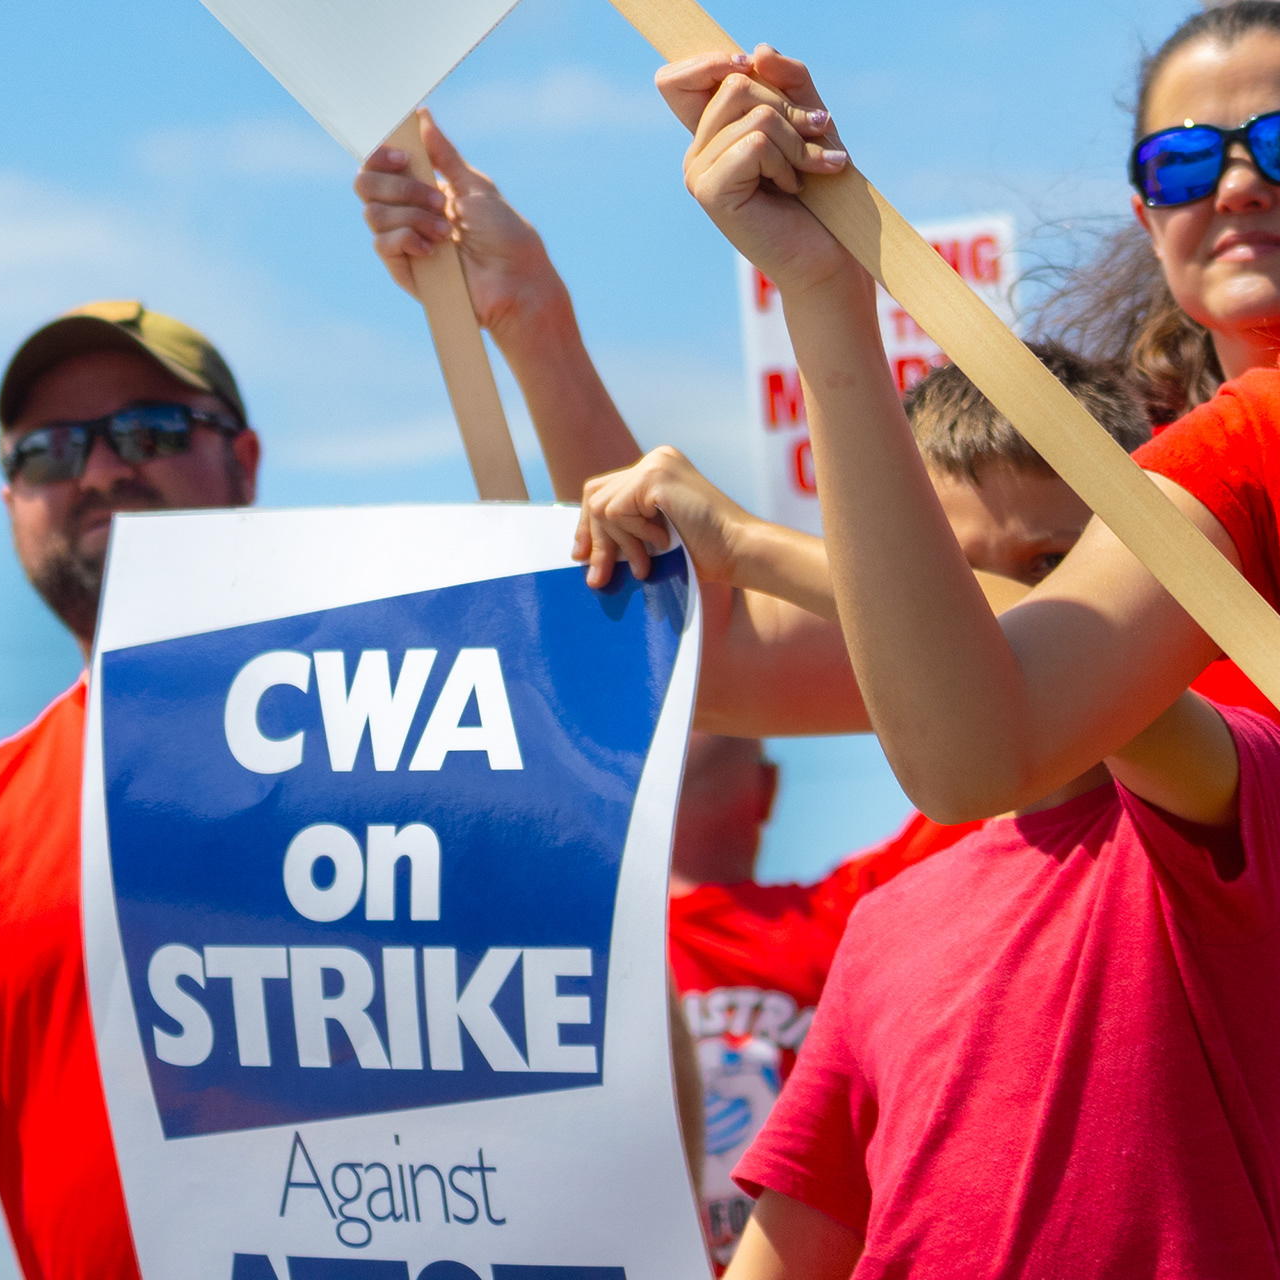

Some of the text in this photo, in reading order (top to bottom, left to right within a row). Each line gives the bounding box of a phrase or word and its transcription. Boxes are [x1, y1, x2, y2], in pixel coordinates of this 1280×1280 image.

[224, 647, 523, 774] CWA
[283, 822, 440, 922] on
[148, 943, 598, 1074] STRIKE
[279, 1131, 506, 1249] Against
